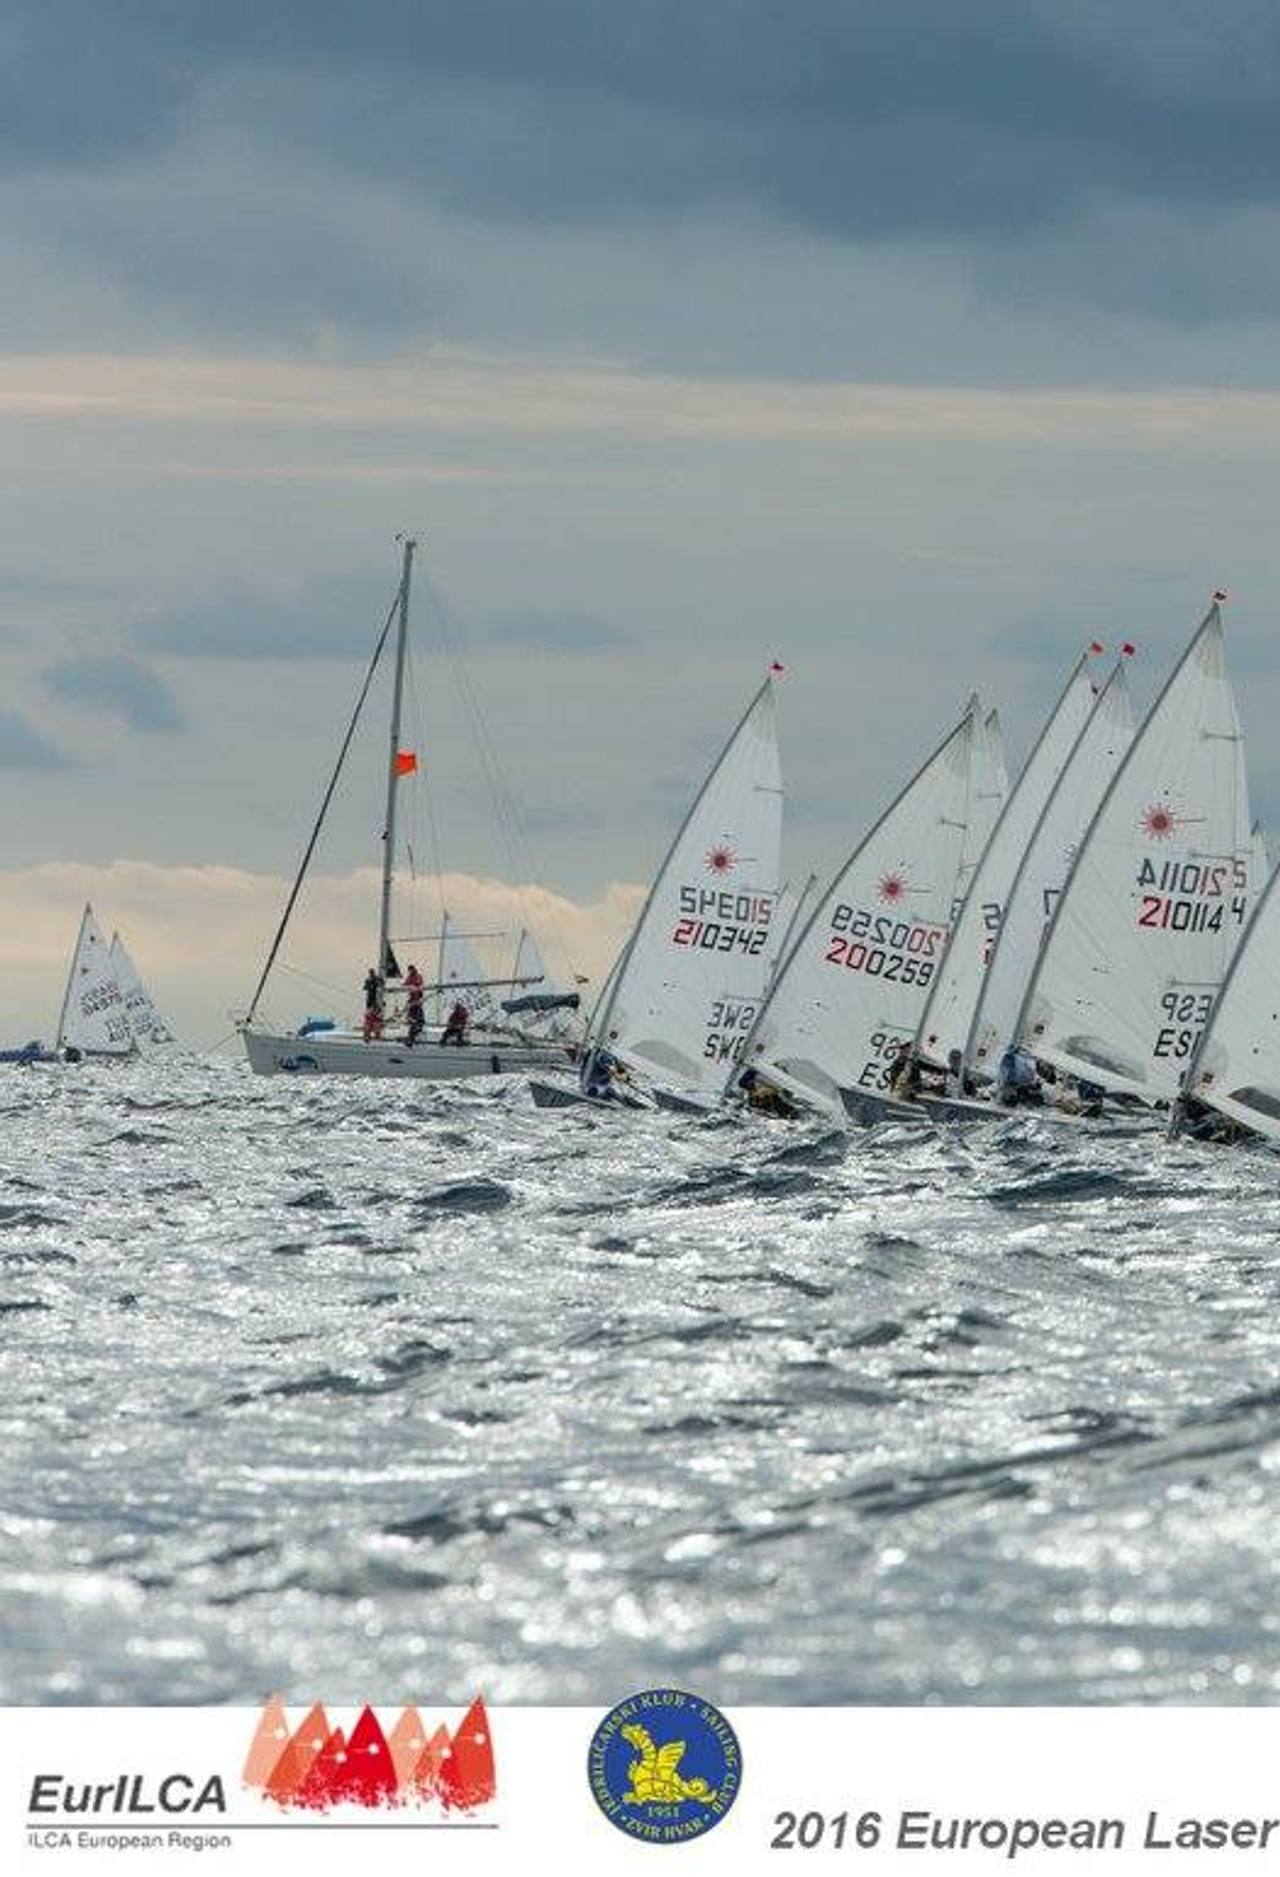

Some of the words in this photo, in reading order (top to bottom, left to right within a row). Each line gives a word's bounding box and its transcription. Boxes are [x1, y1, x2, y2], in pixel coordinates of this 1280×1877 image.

[1138, 896, 1224, 934] 210114
[672, 918, 768, 956] 210342
[825, 938, 935, 987] 200259
[857, 1062, 893, 1090] ES
